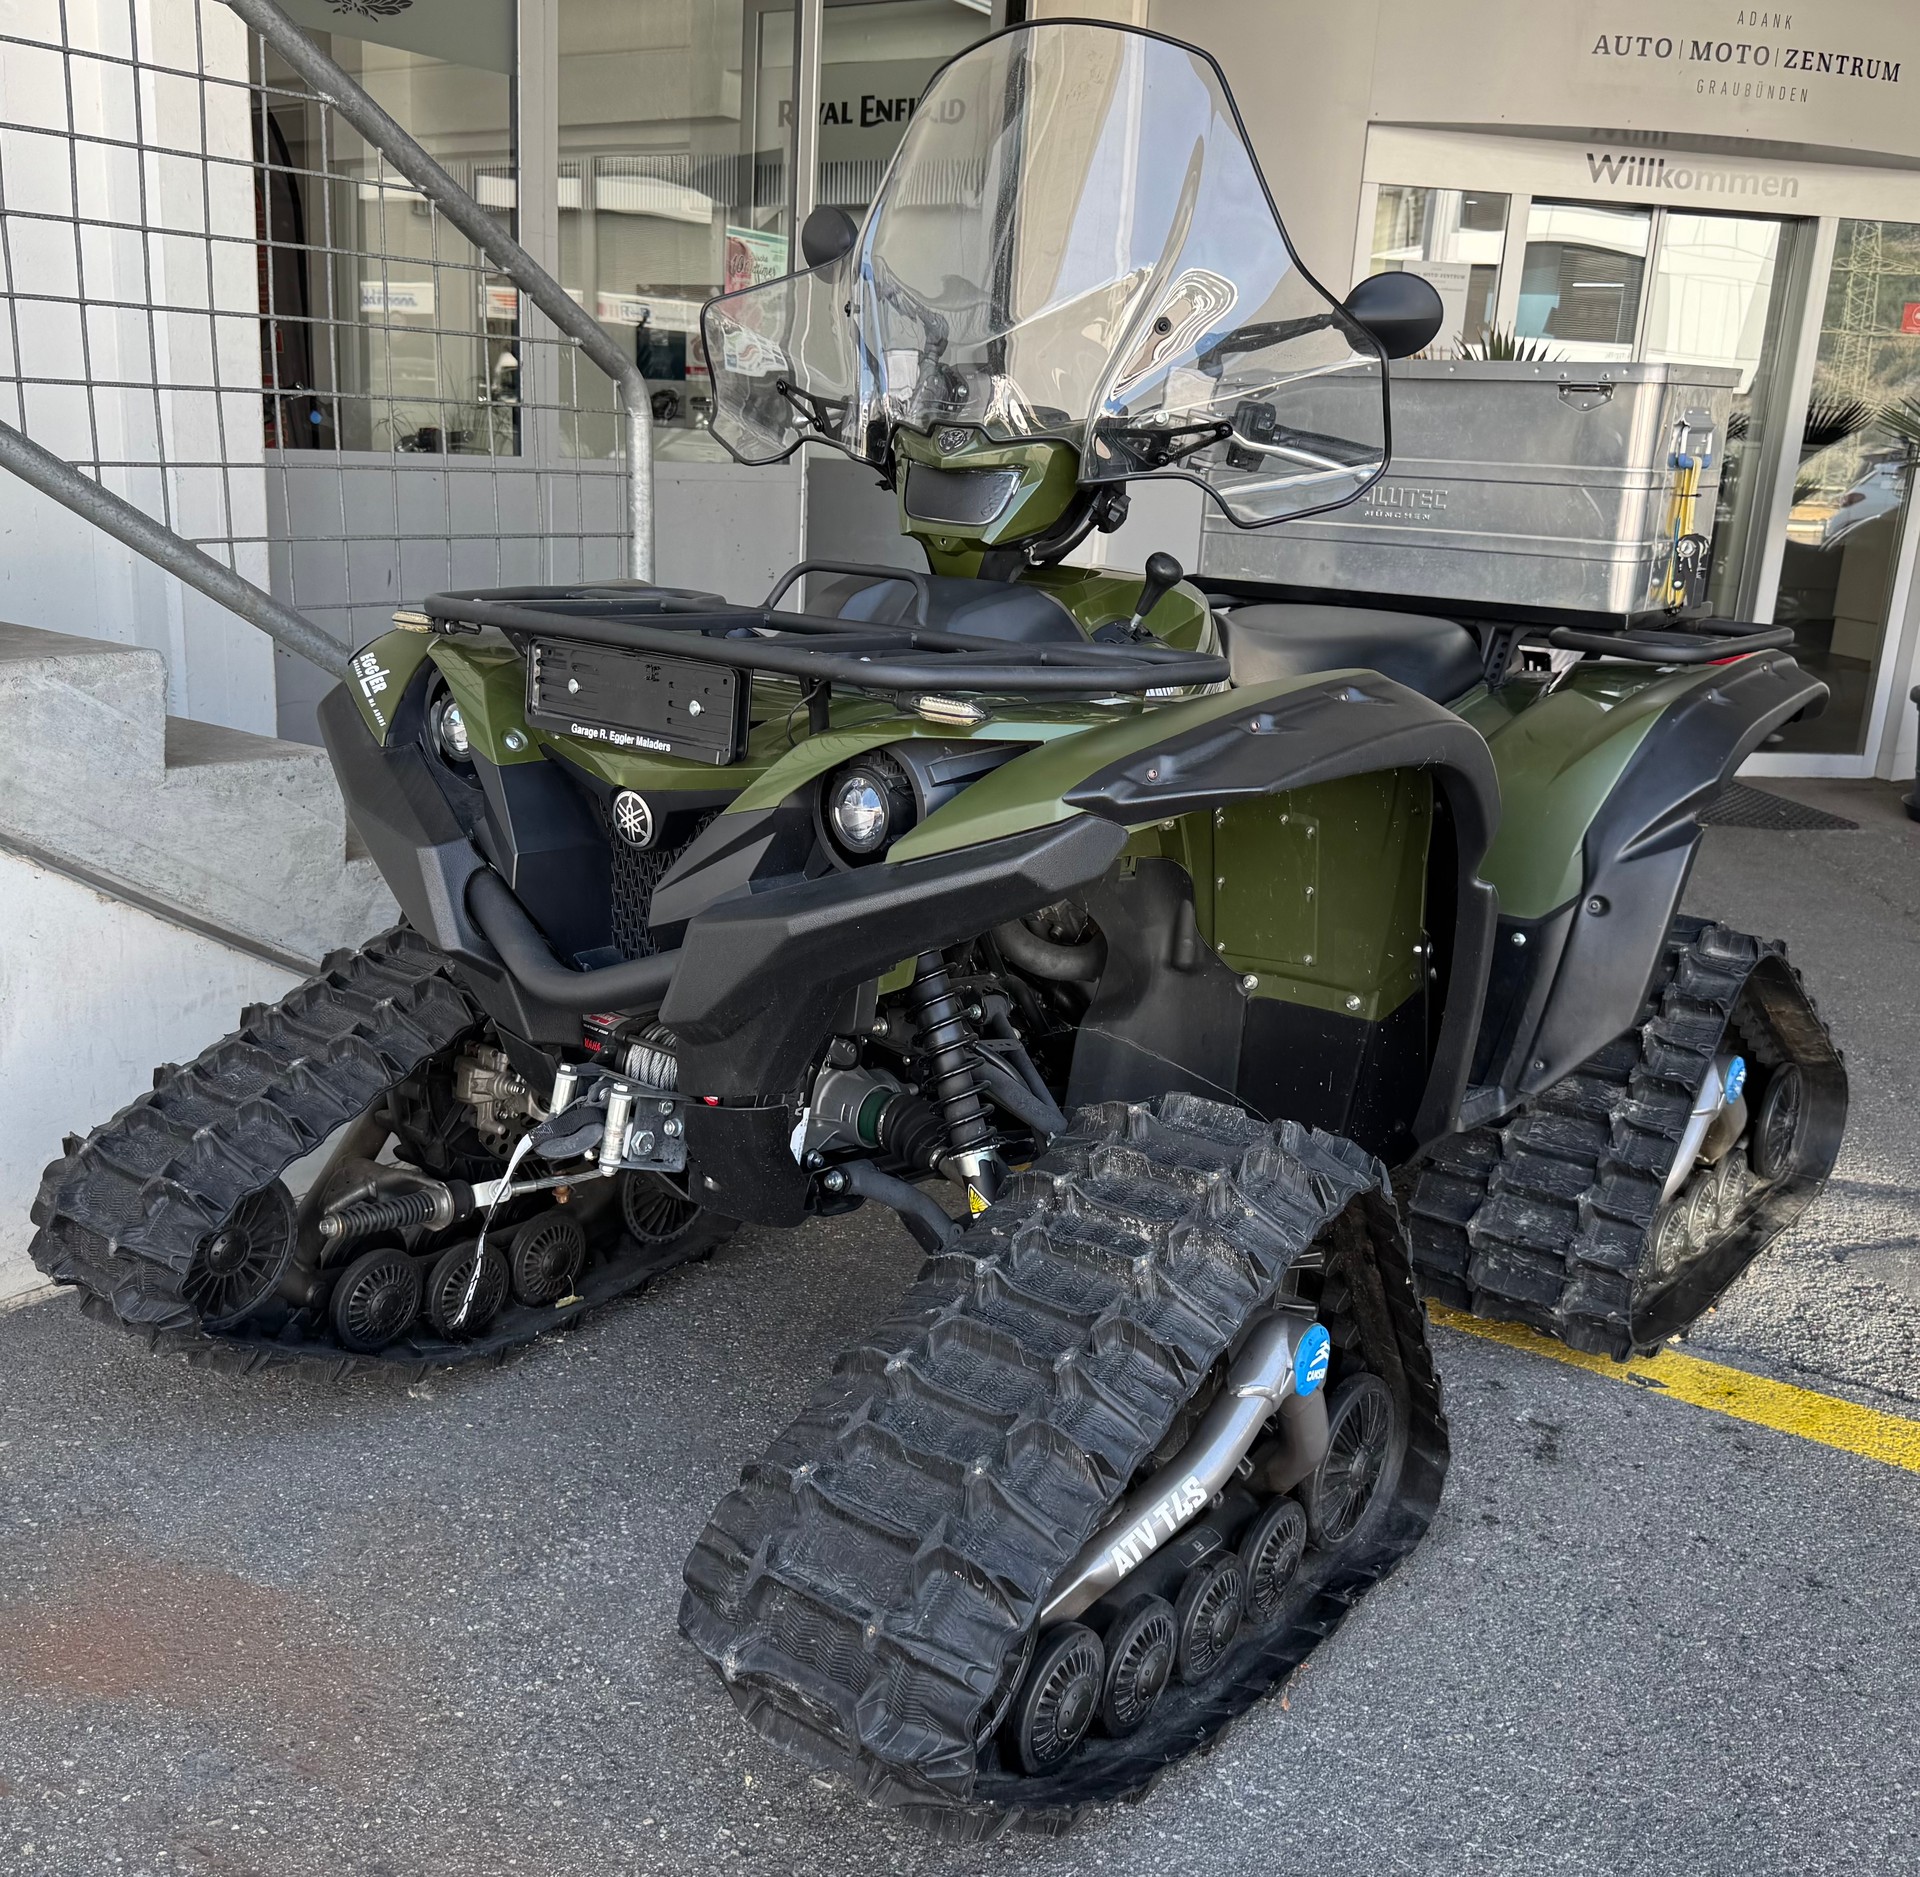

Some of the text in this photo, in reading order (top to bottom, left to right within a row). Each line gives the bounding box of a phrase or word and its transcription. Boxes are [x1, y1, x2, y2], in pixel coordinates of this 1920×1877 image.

[1737, 10, 1793, 30] ADANK
[1591, 34, 1901, 82] AUTO MOTO ZENTRUM
[1696, 78, 1808, 103] GRAUBÜNDEN
[778, 94, 966, 128] RAL ENFILD
[1586, 152, 1799, 198] Willkommen
[1364, 509, 1431, 521] MÜNCHEN
[359, 652, 390, 698] EGGLER
[570, 722, 671, 752] Garage R. Eggler Maladers
[1110, 1475, 1208, 1577] ATV T4S
